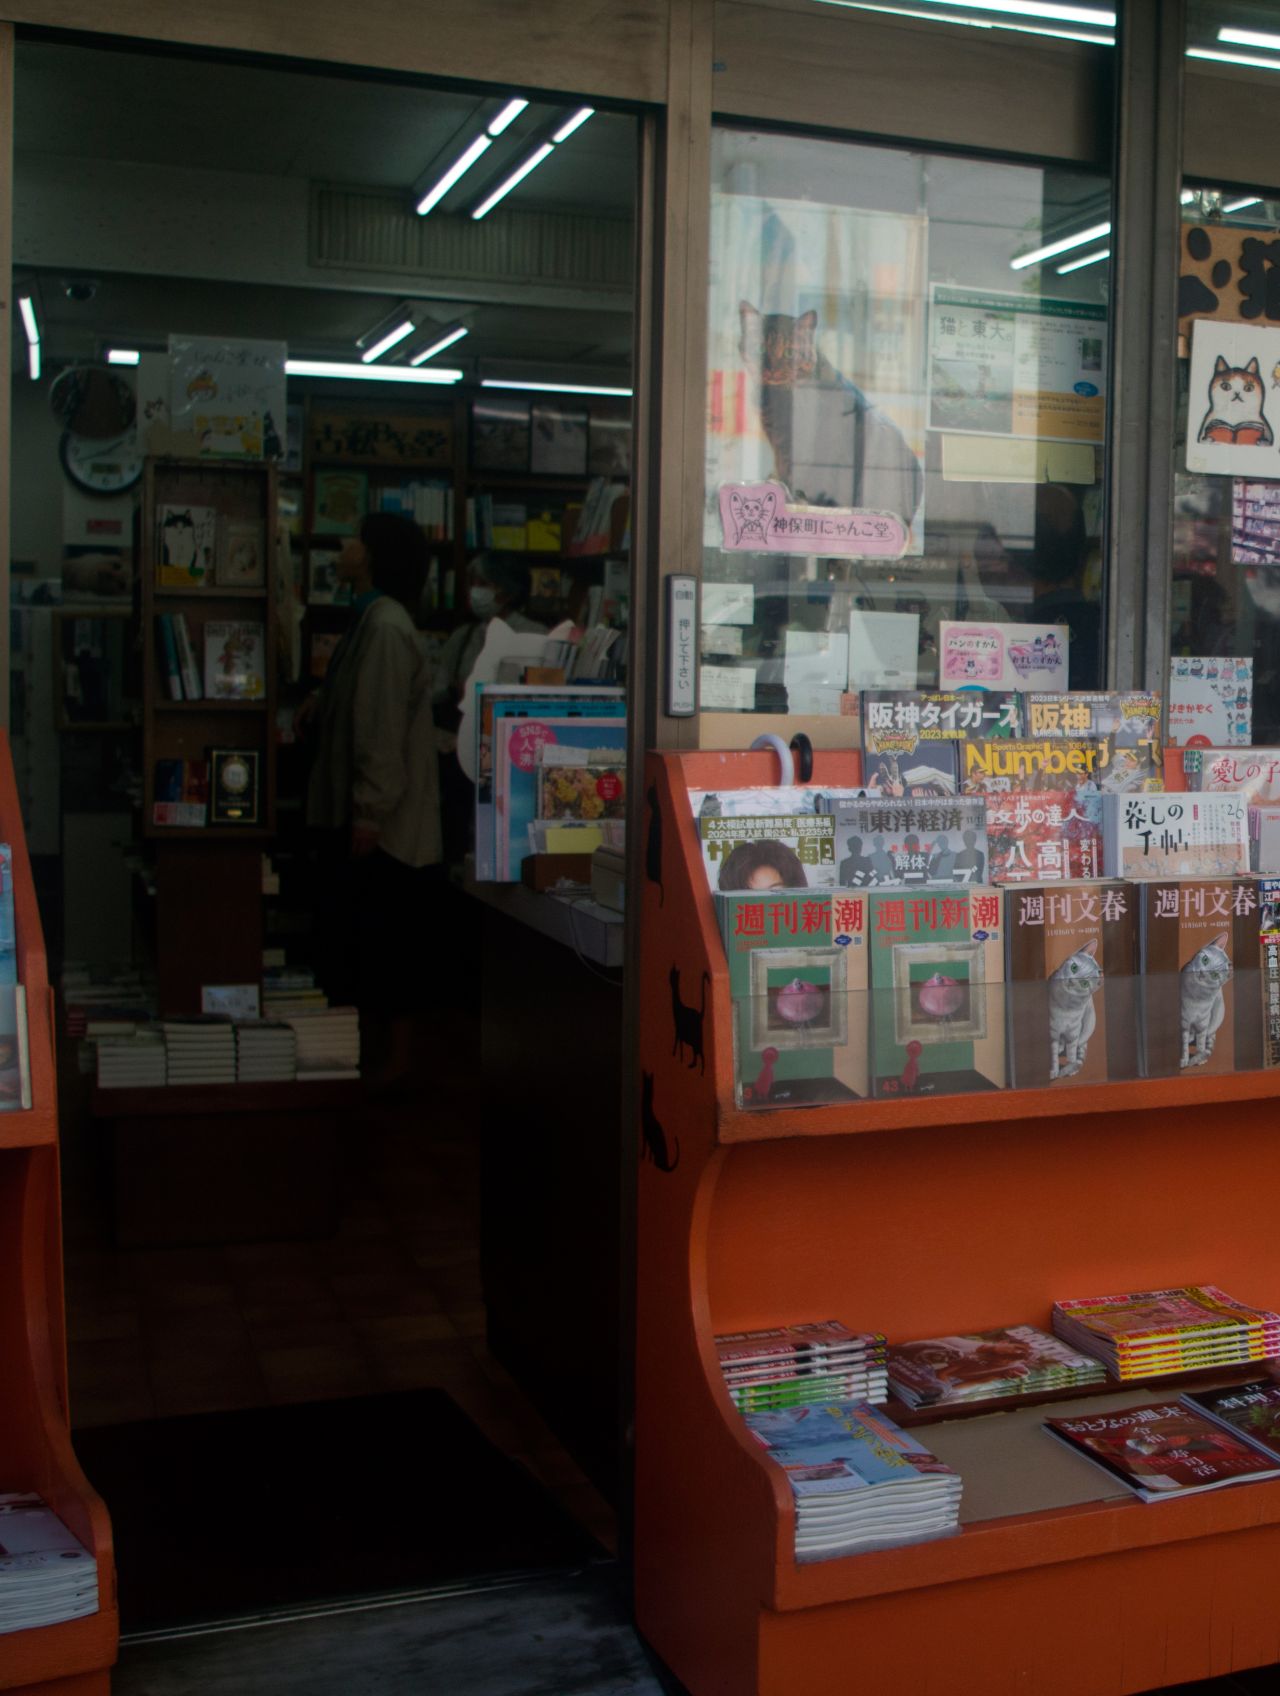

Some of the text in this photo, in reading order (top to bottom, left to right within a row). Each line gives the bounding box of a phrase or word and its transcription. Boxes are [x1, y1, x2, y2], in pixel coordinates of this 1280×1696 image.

[772, 516, 891, 539] 神保町にゃんこ堂
[868, 702, 1019, 730] 阪神タイガース
[1031, 703, 1091, 732] 阪神
[966, 742, 1097, 777] Number
[870, 809, 962, 833] 東洋経済
[876, 895, 1000, 933] 週刊新潮
[1019, 890, 1128, 927] 週刊文春
[1154, 885, 1257, 919] 週刊文春
[734, 899, 863, 937] 週刊新潮
[1061, 1405, 1188, 1434] おとなの週末
